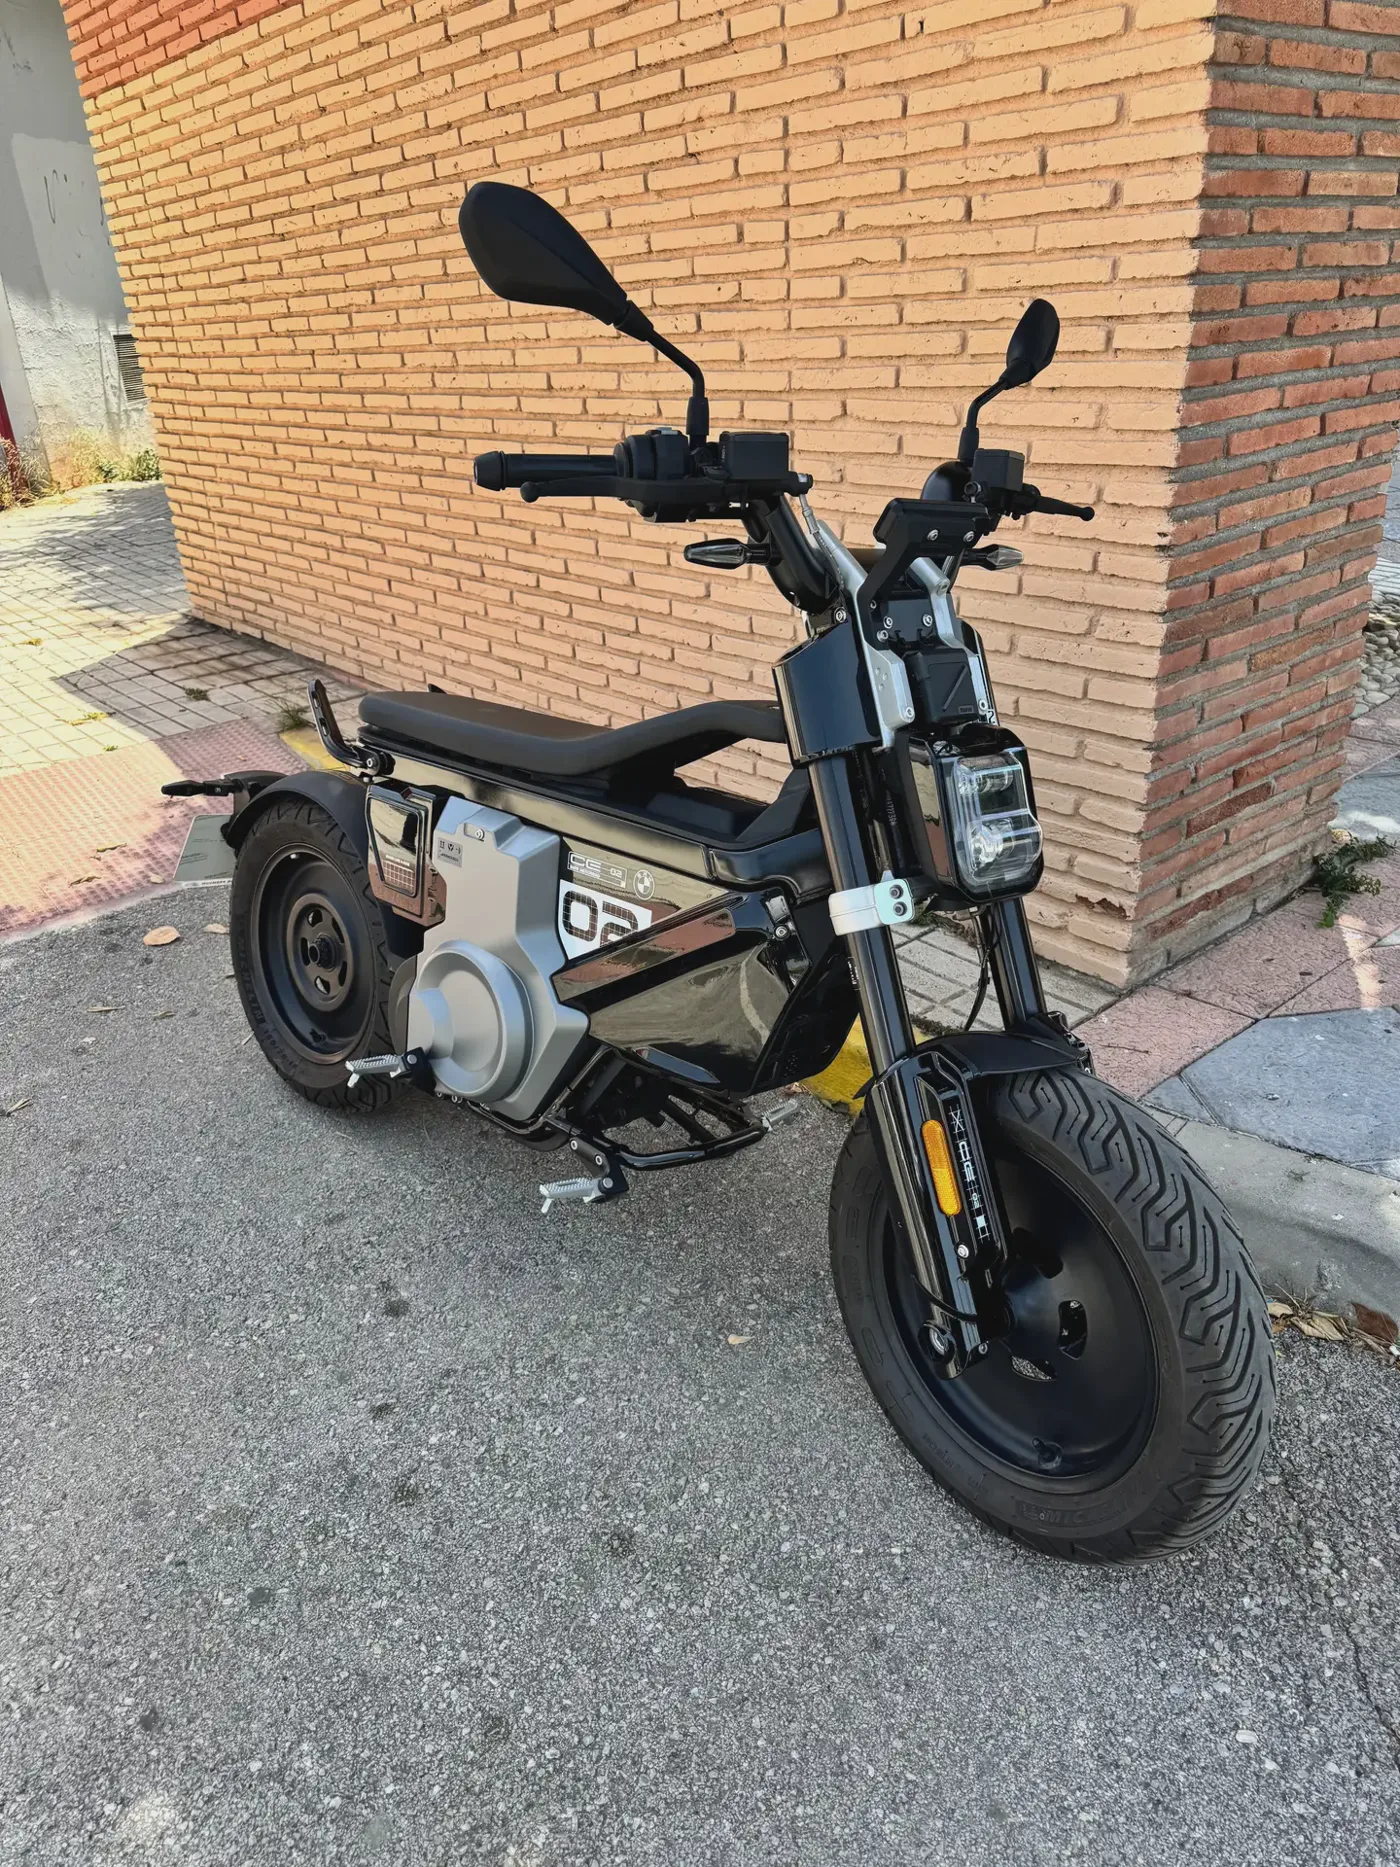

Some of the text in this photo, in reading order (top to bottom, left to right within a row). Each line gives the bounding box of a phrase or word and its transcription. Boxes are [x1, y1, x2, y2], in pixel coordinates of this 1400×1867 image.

[570, 853, 602, 873] CE
[610, 867, 623, 879] 02
[562, 890, 639, 947] 02
[959, 1141, 975, 1181] CE
